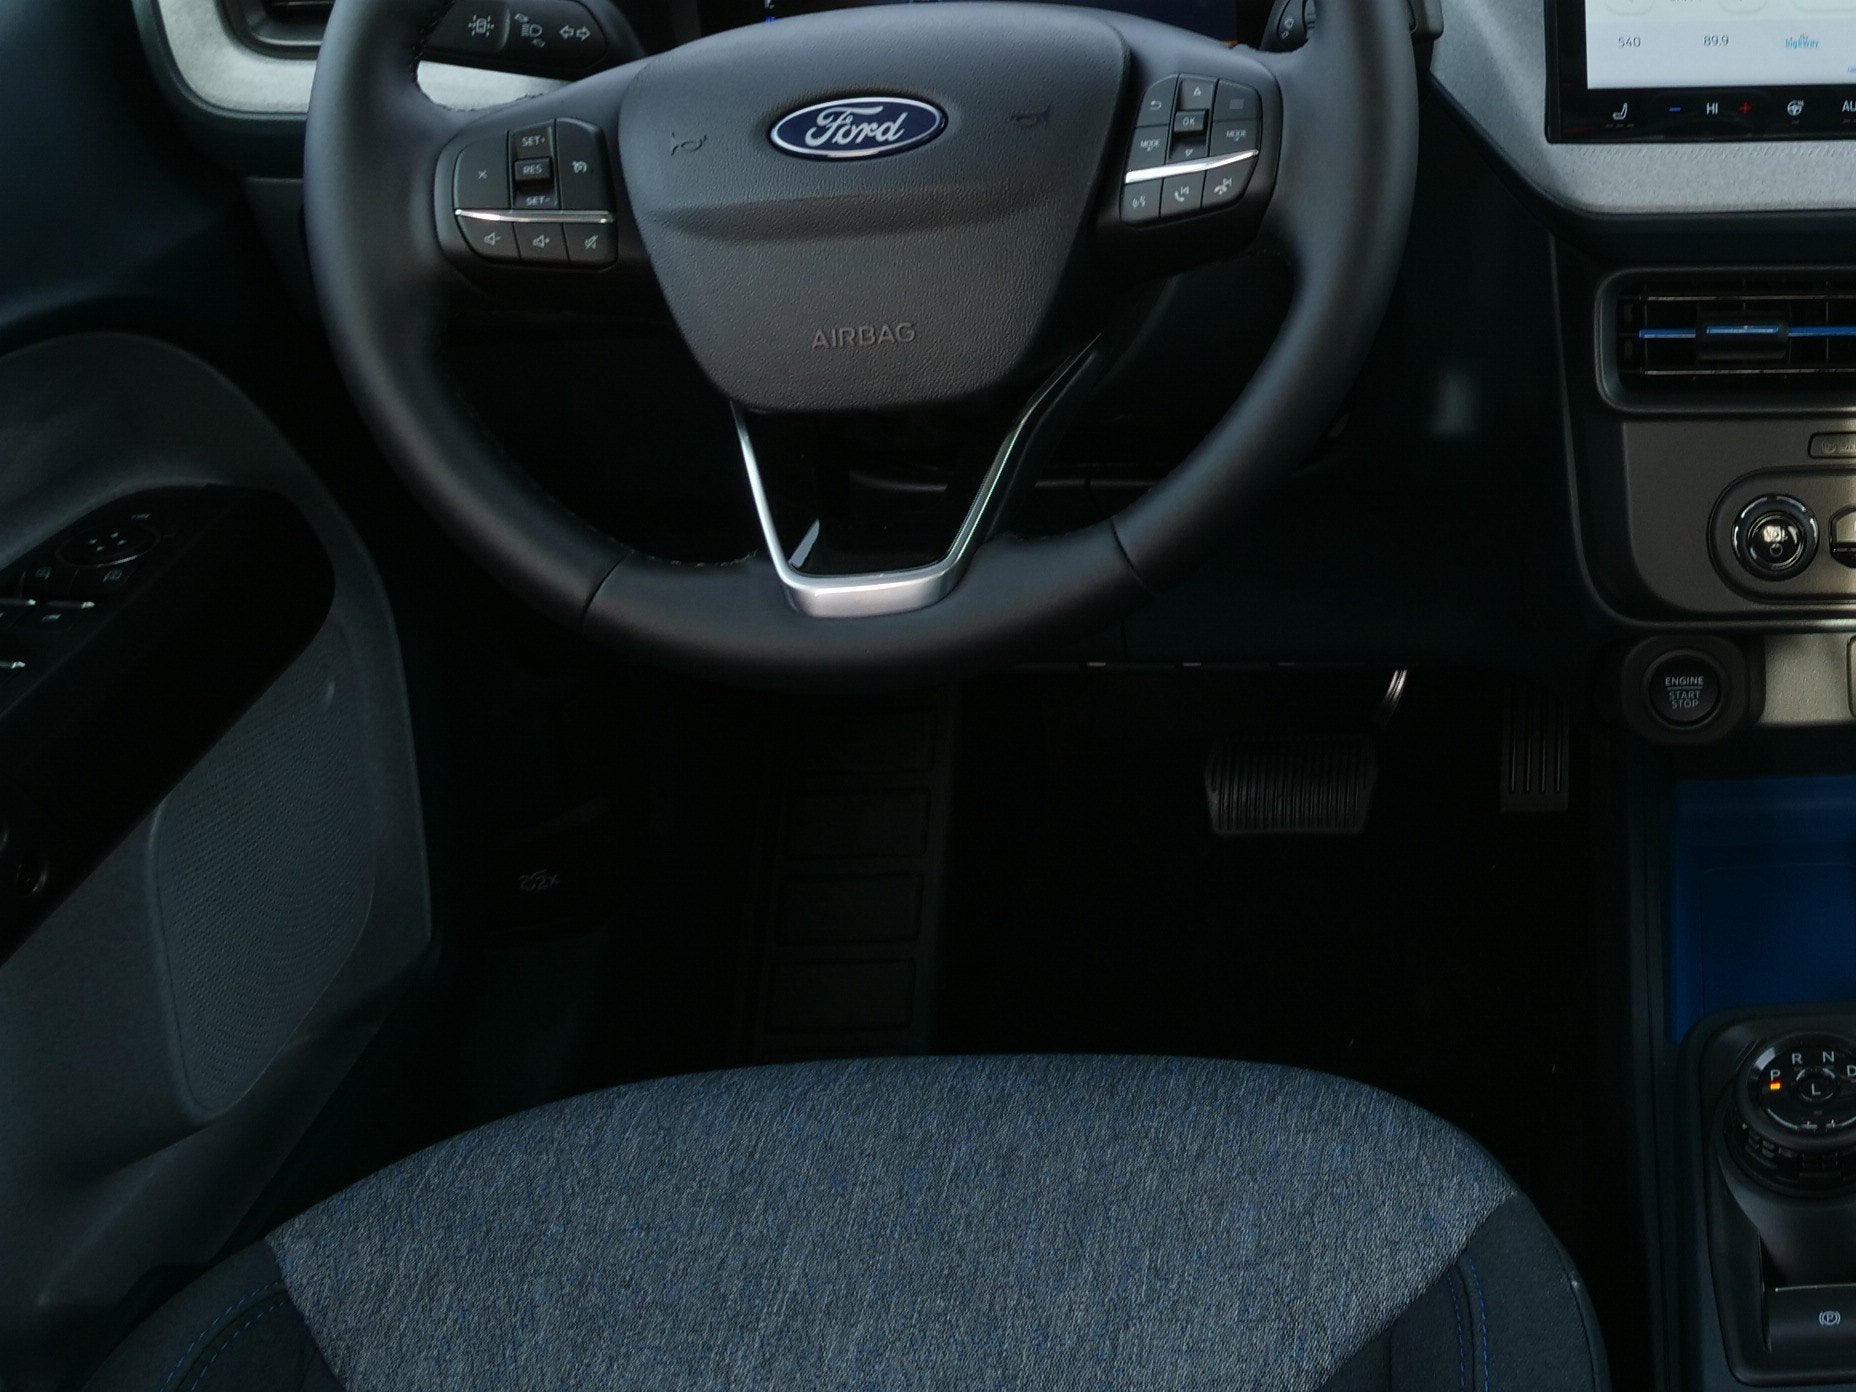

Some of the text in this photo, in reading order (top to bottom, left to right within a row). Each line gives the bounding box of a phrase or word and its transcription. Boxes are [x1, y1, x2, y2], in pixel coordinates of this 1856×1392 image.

[1617, 37, 1641, 48] 540
[1703, 36, 1729, 47] 89.9
[1706, 102, 1719, 115] HI
[805, 104, 905, 147] Ford
[1183, 116, 1195, 127] OK
[1227, 128, 1247, 141] MODE
[1140, 138, 1160, 151] MODE
[523, 163, 543, 176] RES
[811, 322, 917, 352] AIRBAG
[1665, 675, 1704, 686] ENGINE
[1669, 690, 1700, 700] START
[1671, 698, 1699, 709] STOP
[1791, 1053, 1803, 1064] R
[1822, 1051, 1835, 1063] N
[1770, 1069, 1781, 1081] P
[1811, 1083, 1821, 1096] L
